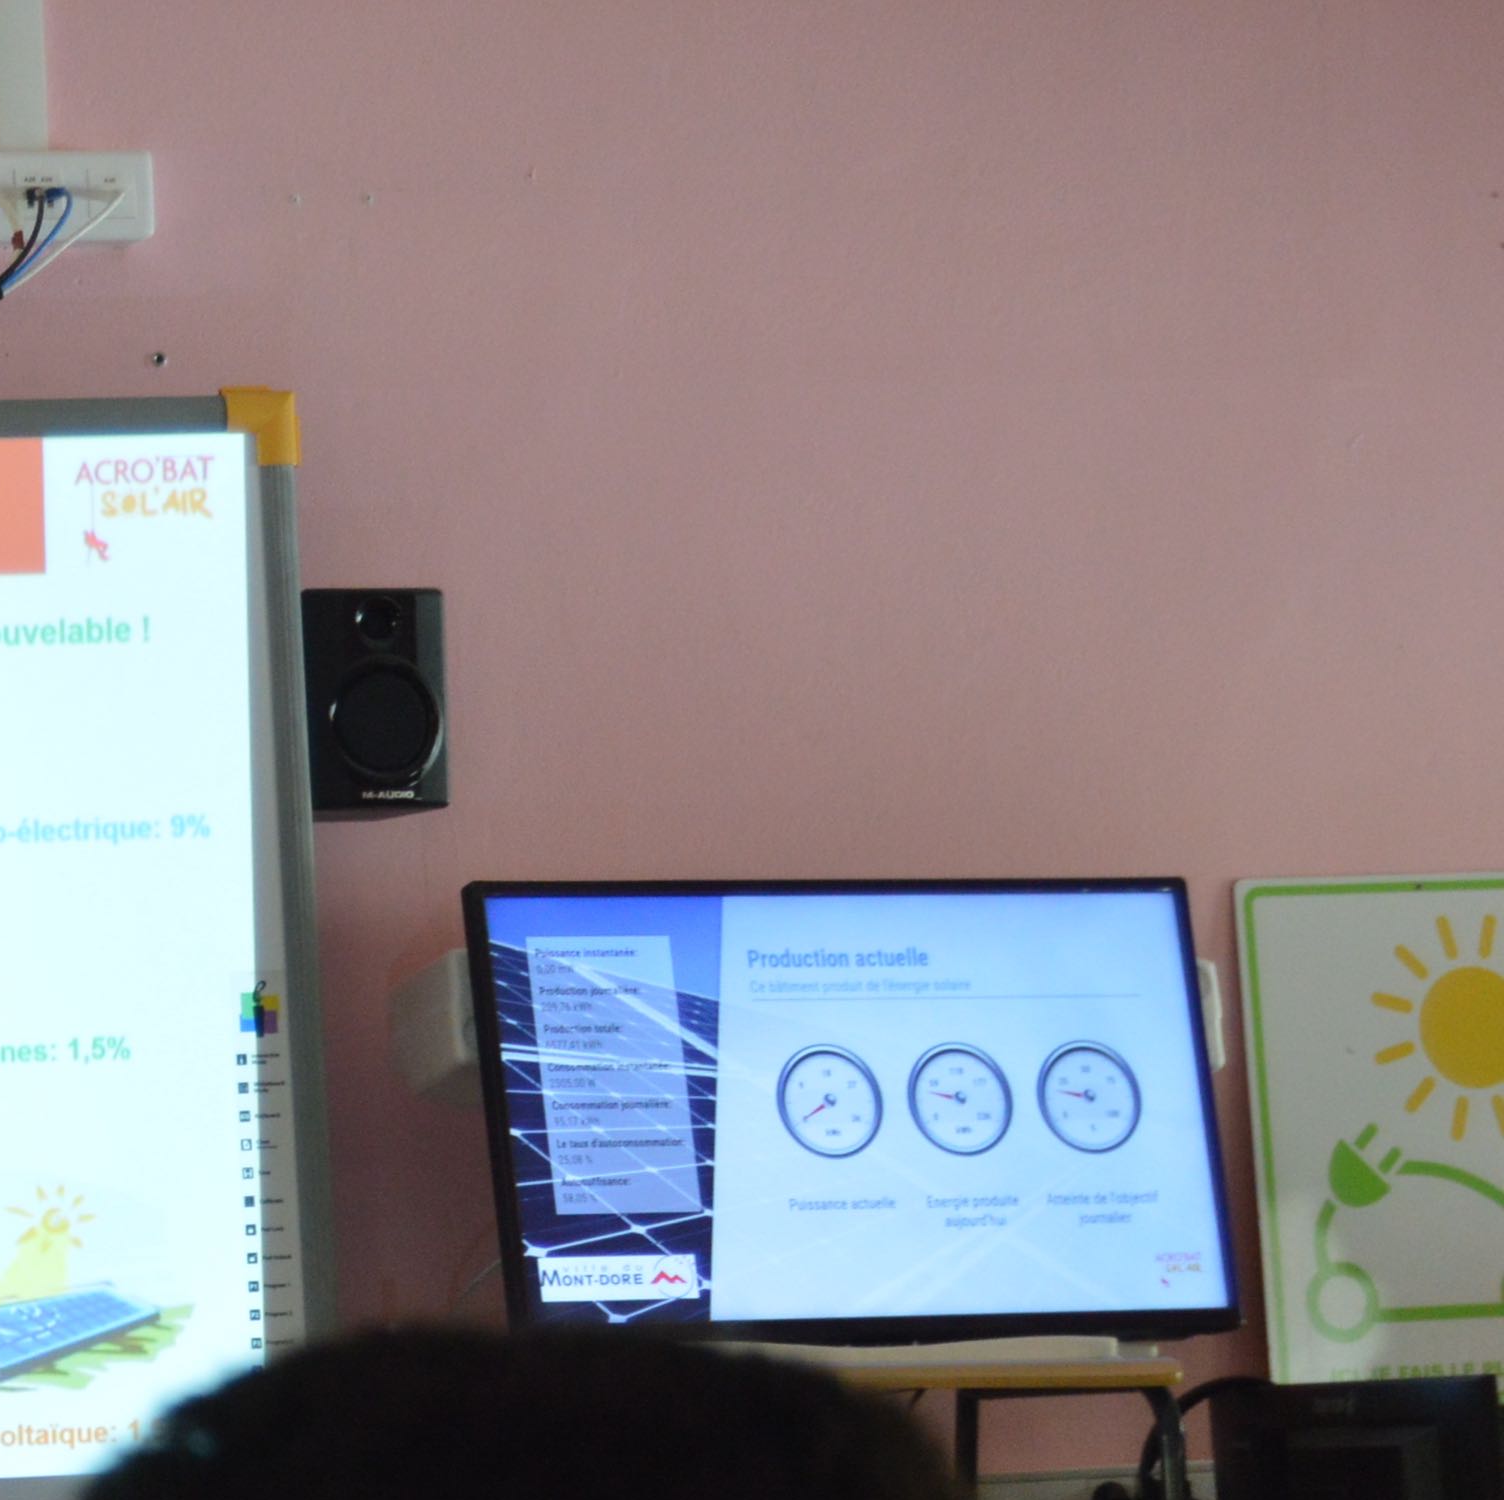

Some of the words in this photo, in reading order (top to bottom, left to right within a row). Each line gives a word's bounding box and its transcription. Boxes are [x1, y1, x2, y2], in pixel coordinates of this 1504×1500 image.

[75, 455, 214, 486] ACRO'BAT
[101, 486, 214, 519] SOL'AIR
[142, 617, 150, 643] !
[362, 790, 414, 799] M-AUDIO
[170, 814, 211, 840] 9%
[747, 950, 850, 970] Production
[856, 947, 929, 968] actuelle
[68, 1036, 131, 1065] 1,5%
[541, 1270, 644, 1287] MONT-DORE
